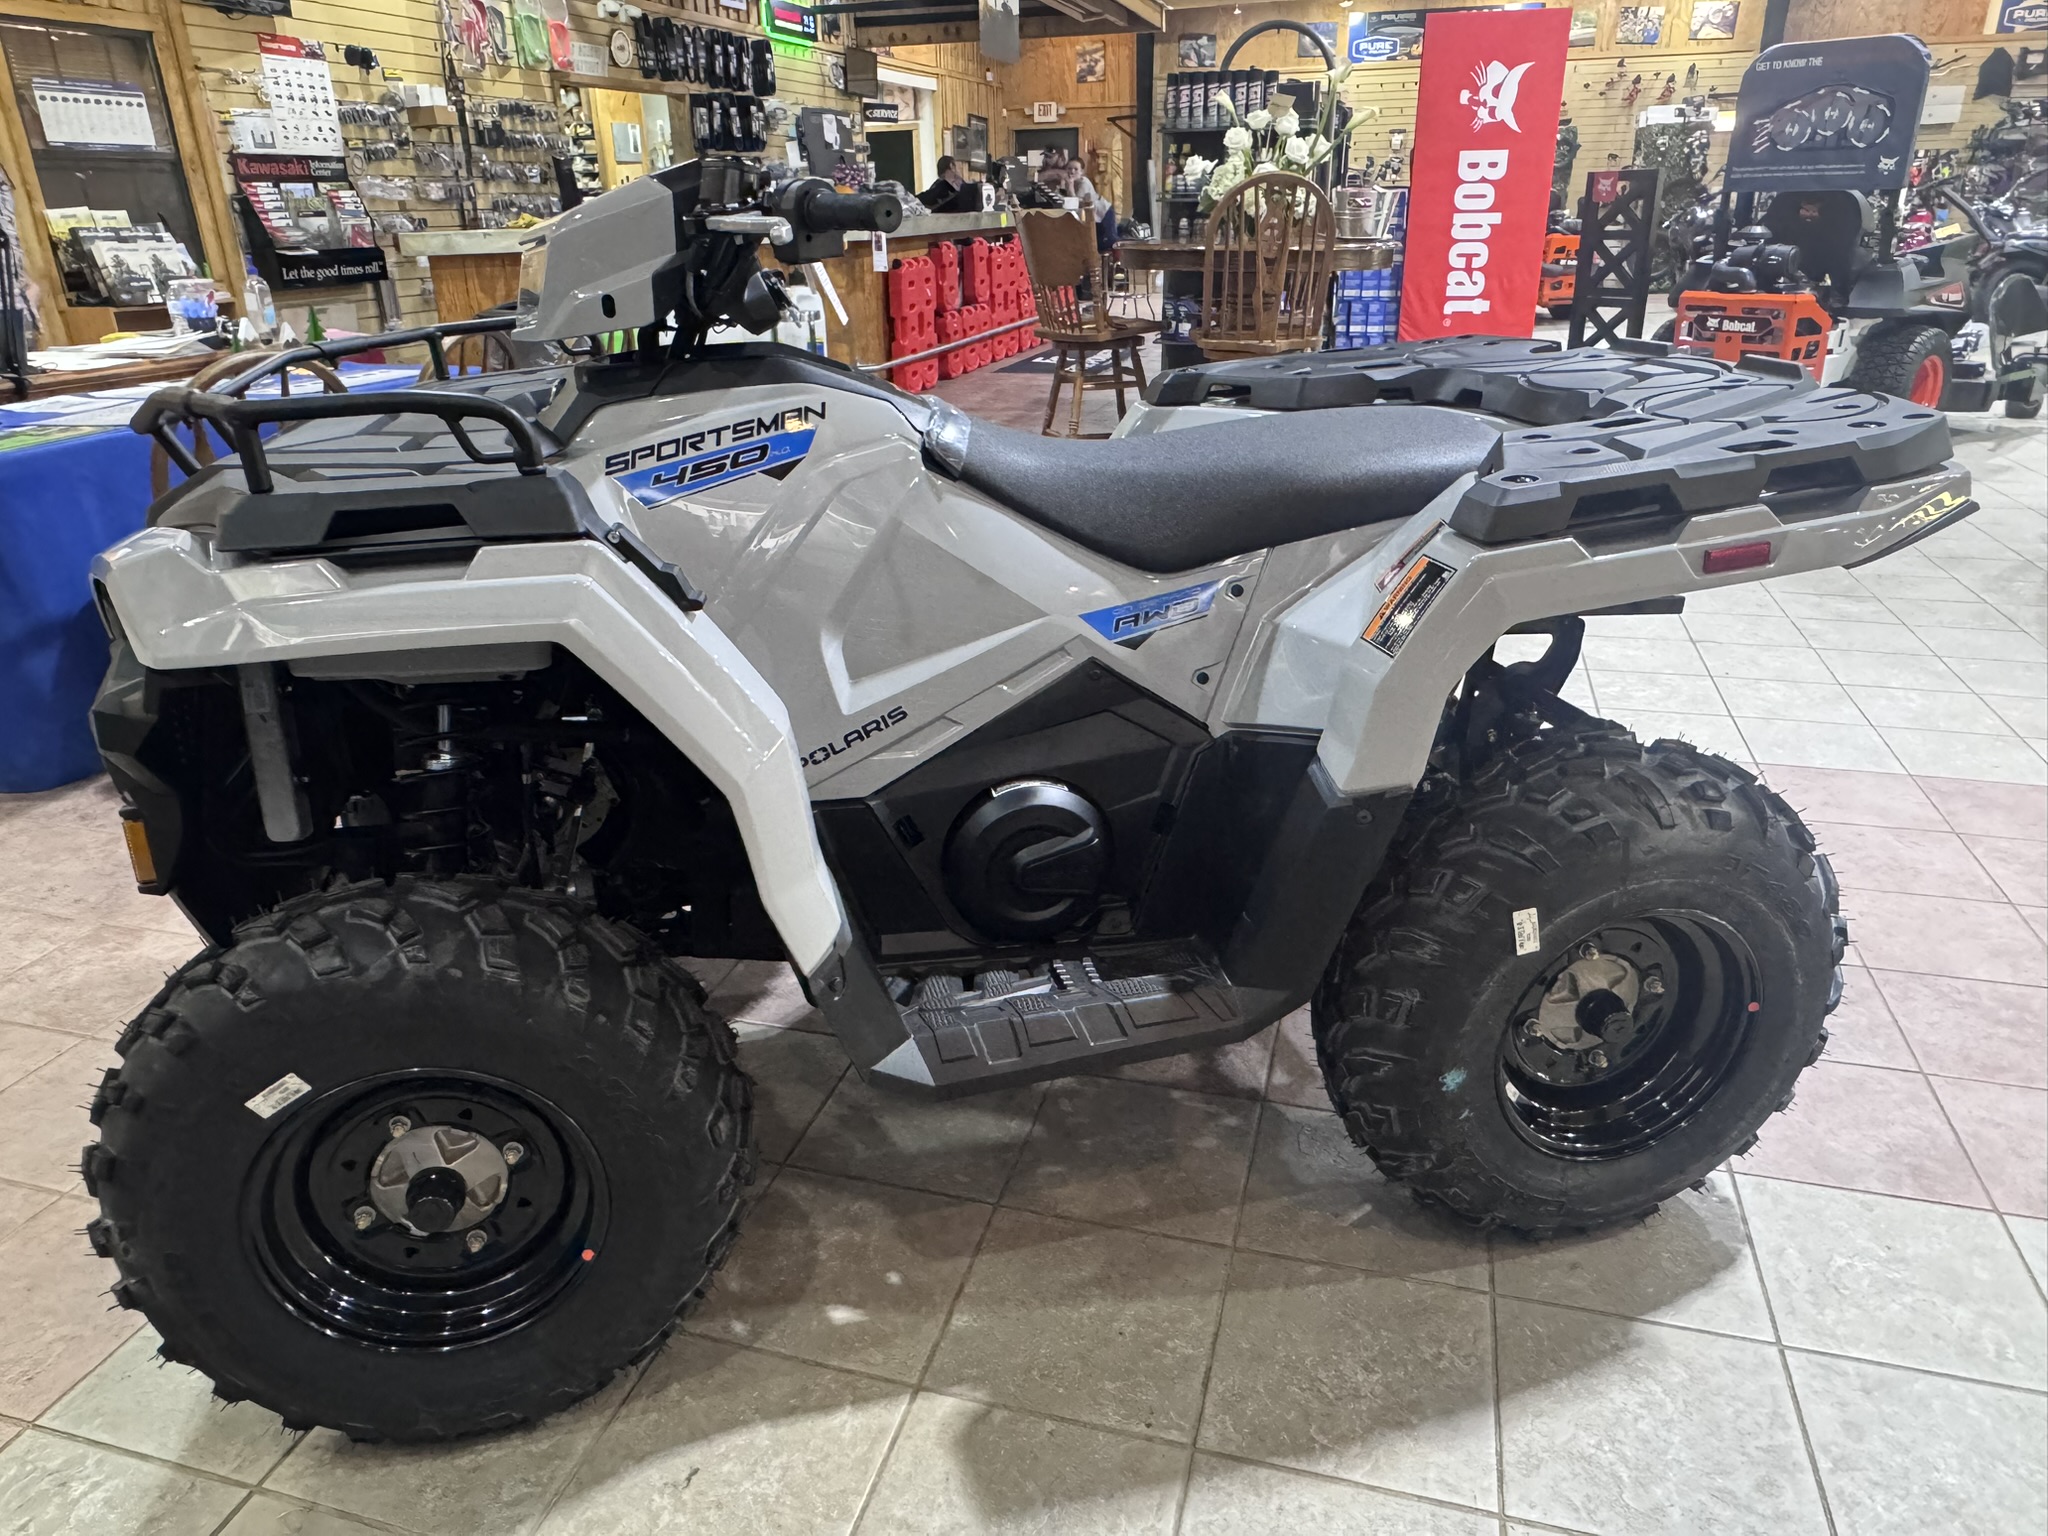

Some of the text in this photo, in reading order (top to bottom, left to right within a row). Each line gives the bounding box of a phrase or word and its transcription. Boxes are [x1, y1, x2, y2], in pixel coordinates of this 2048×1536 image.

[2012, 9, 2048, 19] PUR
[1756, 57, 1823, 71] GET TO KNOW THE
[1038, 103, 1052, 117] EXIT
[236, 157, 310, 176] Kawasaki
[310, 167, 332, 177] Center
[1443, 149, 1509, 315] Bobcat
[282, 266, 299, 280] Let
[300, 265, 315, 279] the
[316, 264, 339, 282] good
[341, 265, 364, 276] times
[1722, 319, 1756, 333] Bobcat
[605, 401, 827, 477] SPORTSMAN
[651, 443, 770, 488] 450
[1382, 575, 1413, 612] WARNING
[1112, 597, 1200, 635] AWD
